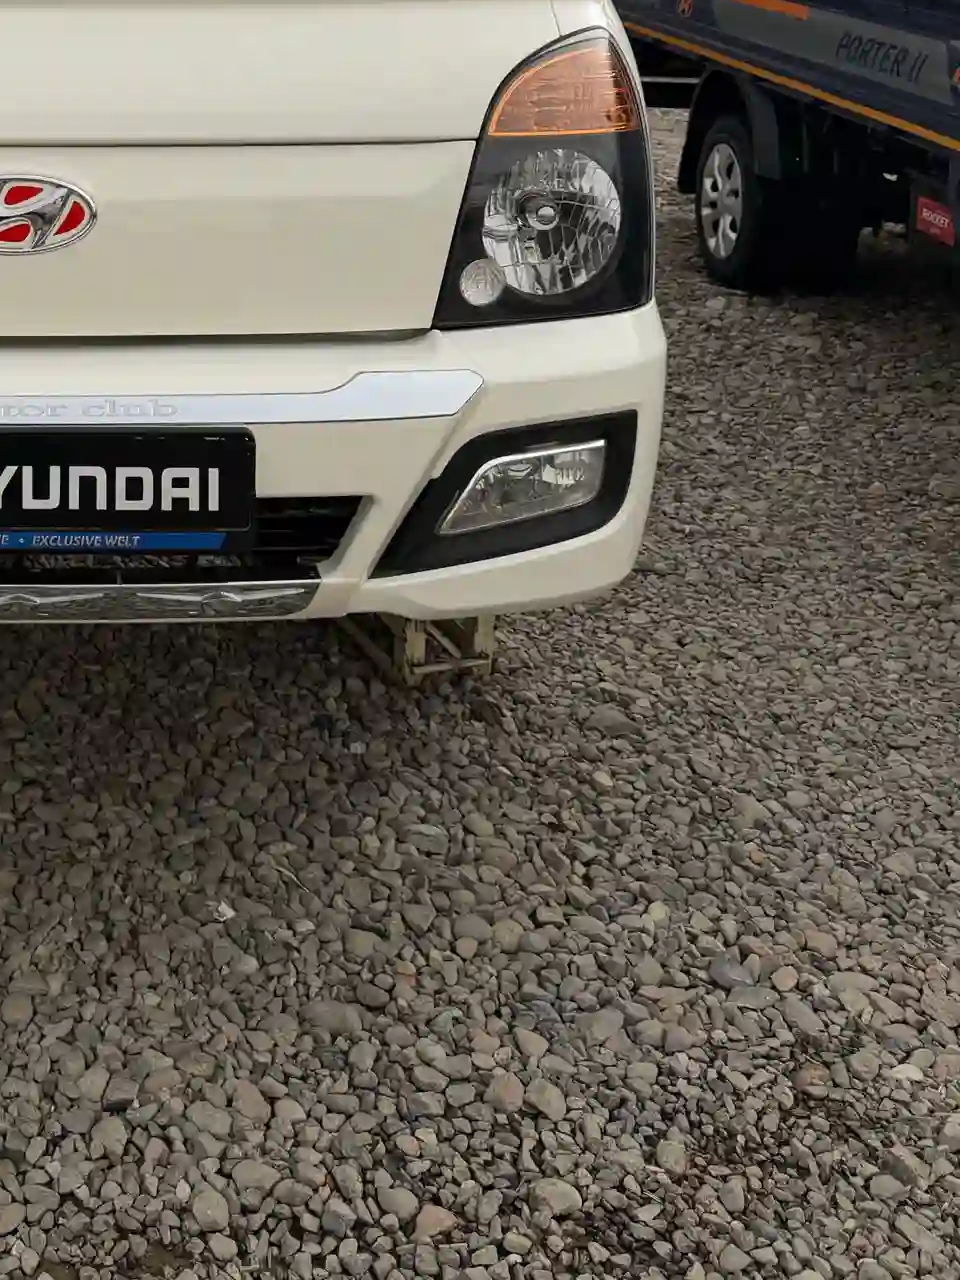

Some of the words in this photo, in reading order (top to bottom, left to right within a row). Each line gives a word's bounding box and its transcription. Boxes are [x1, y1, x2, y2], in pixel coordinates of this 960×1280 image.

[835, 31, 910, 78] PORTER
[80, 398, 180, 418] club
[31, 535, 102, 548] EXCLUSIVE
[104, 536, 141, 549] WELT
